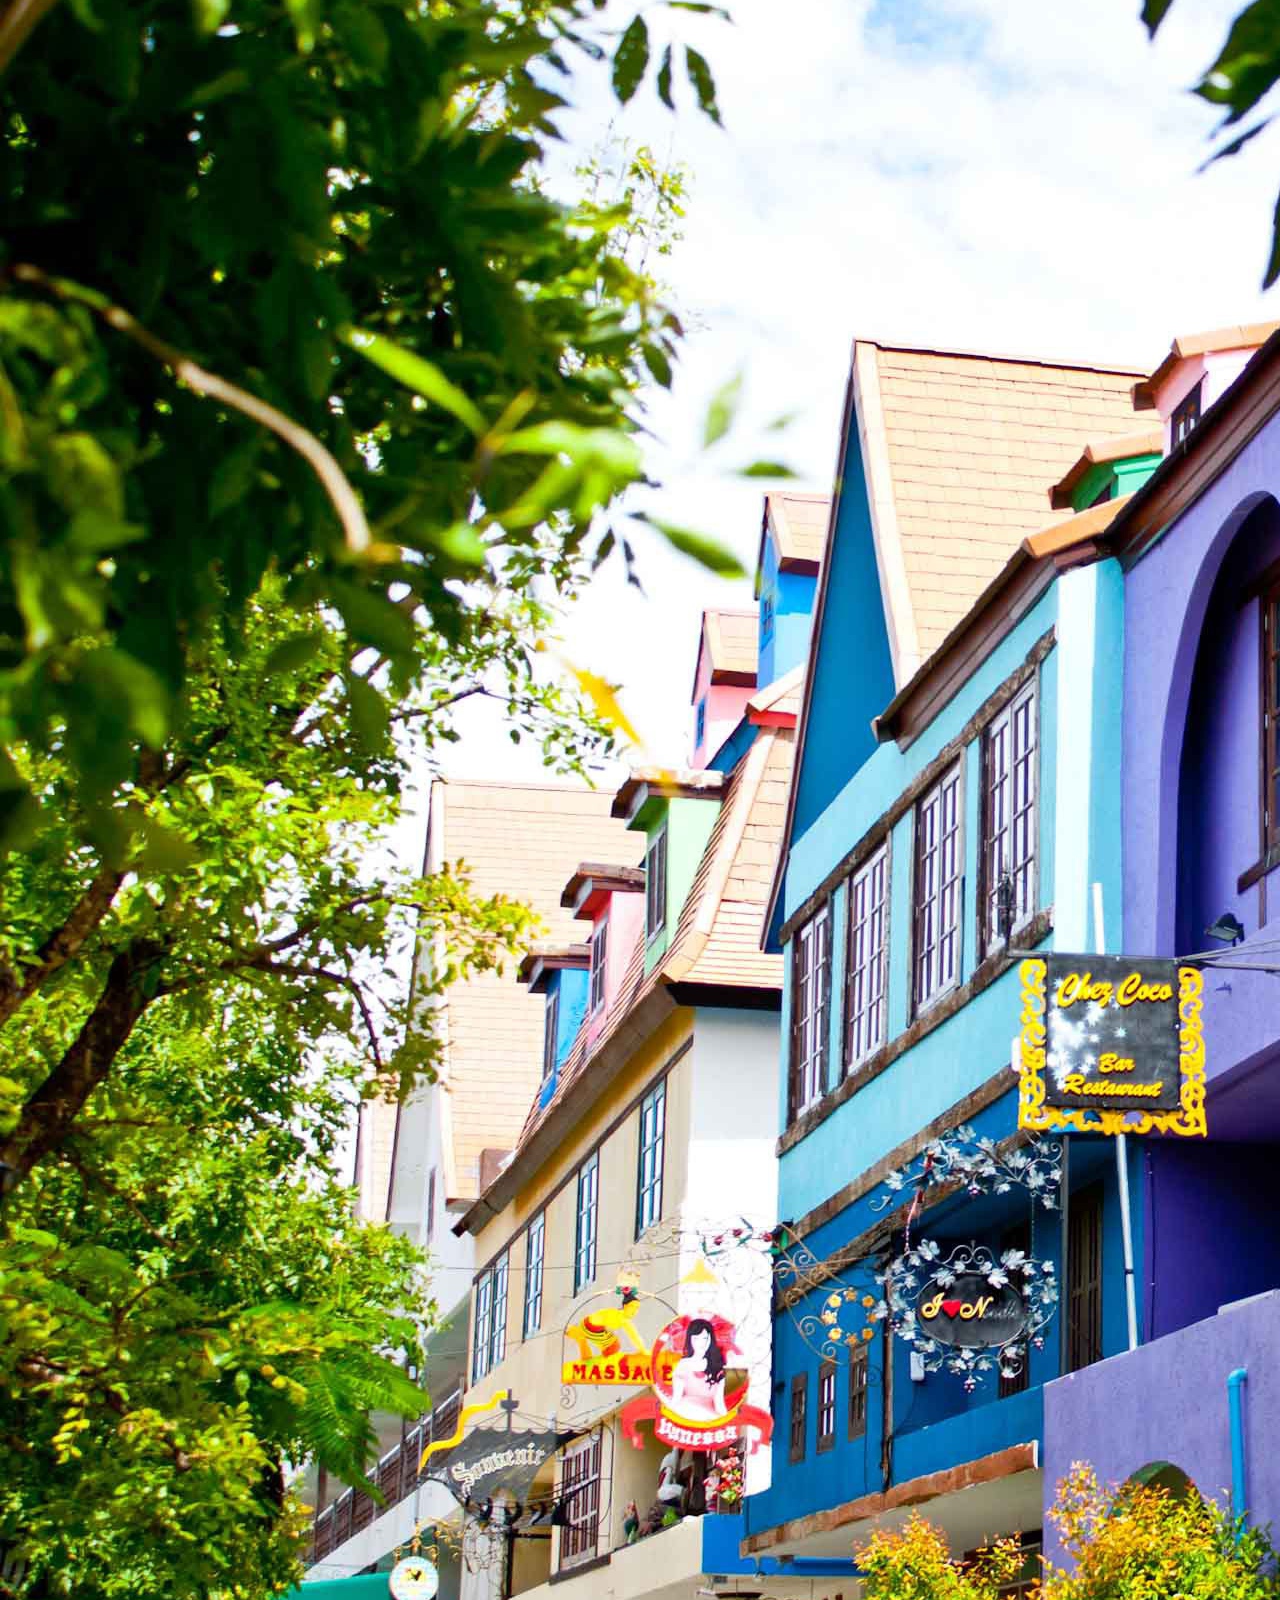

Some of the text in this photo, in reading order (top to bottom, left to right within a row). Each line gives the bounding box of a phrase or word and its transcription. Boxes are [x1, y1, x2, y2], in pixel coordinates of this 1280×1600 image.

[1056, 971, 1174, 1008] Chez Coco
[1098, 1052, 1137, 1074] Bar
[1063, 1073, 1164, 1098] Restaurant
[451, 1442, 546, 1499] Souvenir
